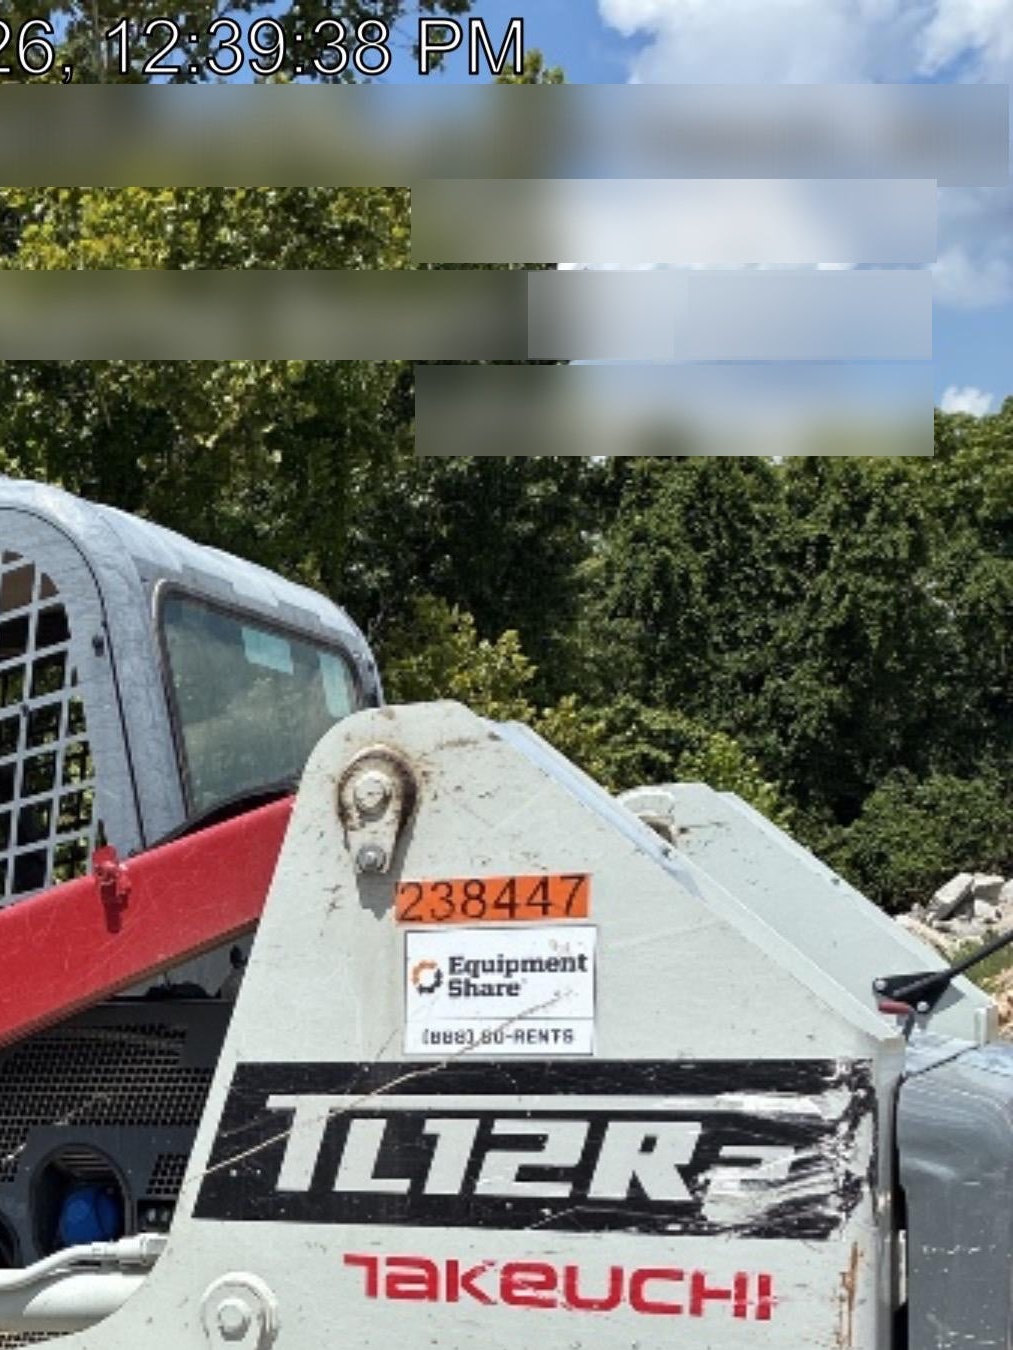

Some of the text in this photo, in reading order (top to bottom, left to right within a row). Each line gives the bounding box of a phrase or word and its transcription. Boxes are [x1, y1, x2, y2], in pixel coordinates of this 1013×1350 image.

[399, 873, 586, 922] 238447
[448, 953, 588, 979] Equipment
[448, 978, 521, 998] Share
